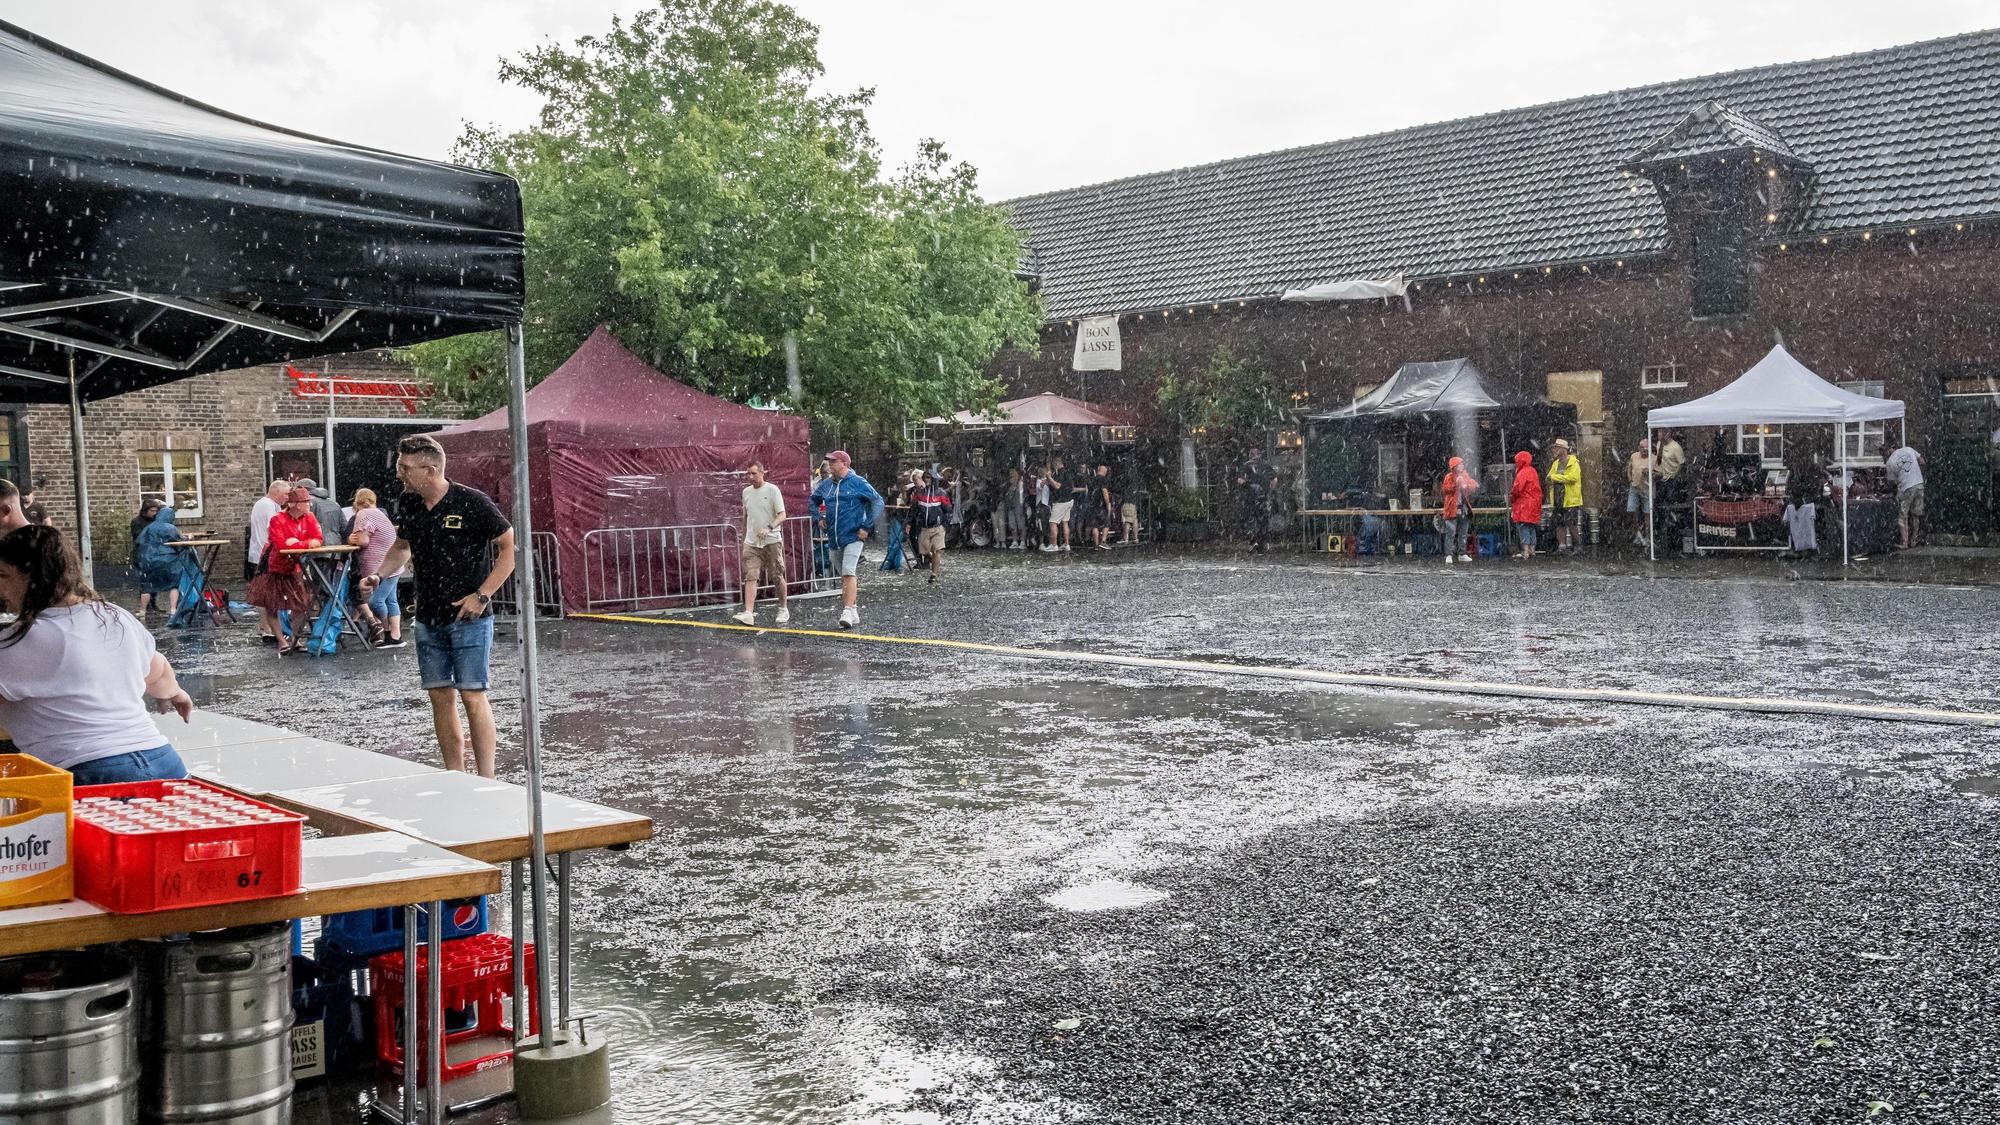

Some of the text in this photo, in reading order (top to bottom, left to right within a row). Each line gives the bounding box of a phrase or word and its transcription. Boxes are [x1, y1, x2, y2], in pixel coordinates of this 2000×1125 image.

[1086, 326, 1110, 338] BON
[0, 861, 48, 874] PEFRUIT
[292, 1025, 317, 1038] FFELS
